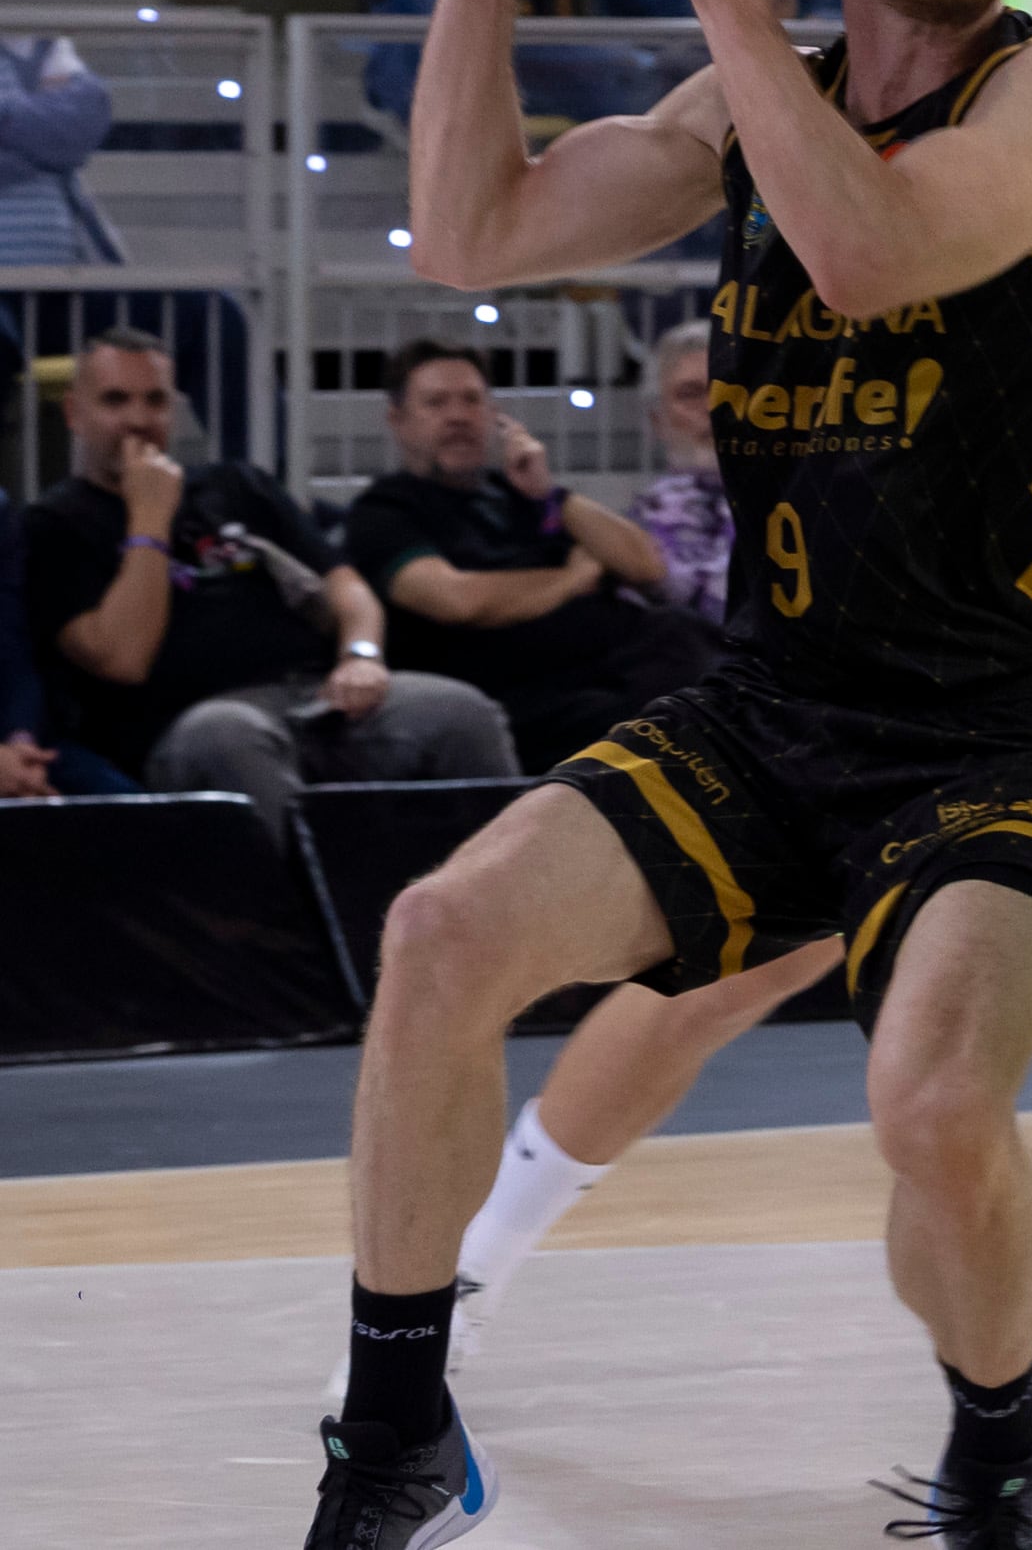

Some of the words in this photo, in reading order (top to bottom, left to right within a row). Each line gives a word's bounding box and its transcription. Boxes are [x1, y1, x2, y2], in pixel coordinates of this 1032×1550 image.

[765, 501, 814, 618] 9
[609, 718, 731, 806] ospiten
[352, 1318, 440, 1341] stral
